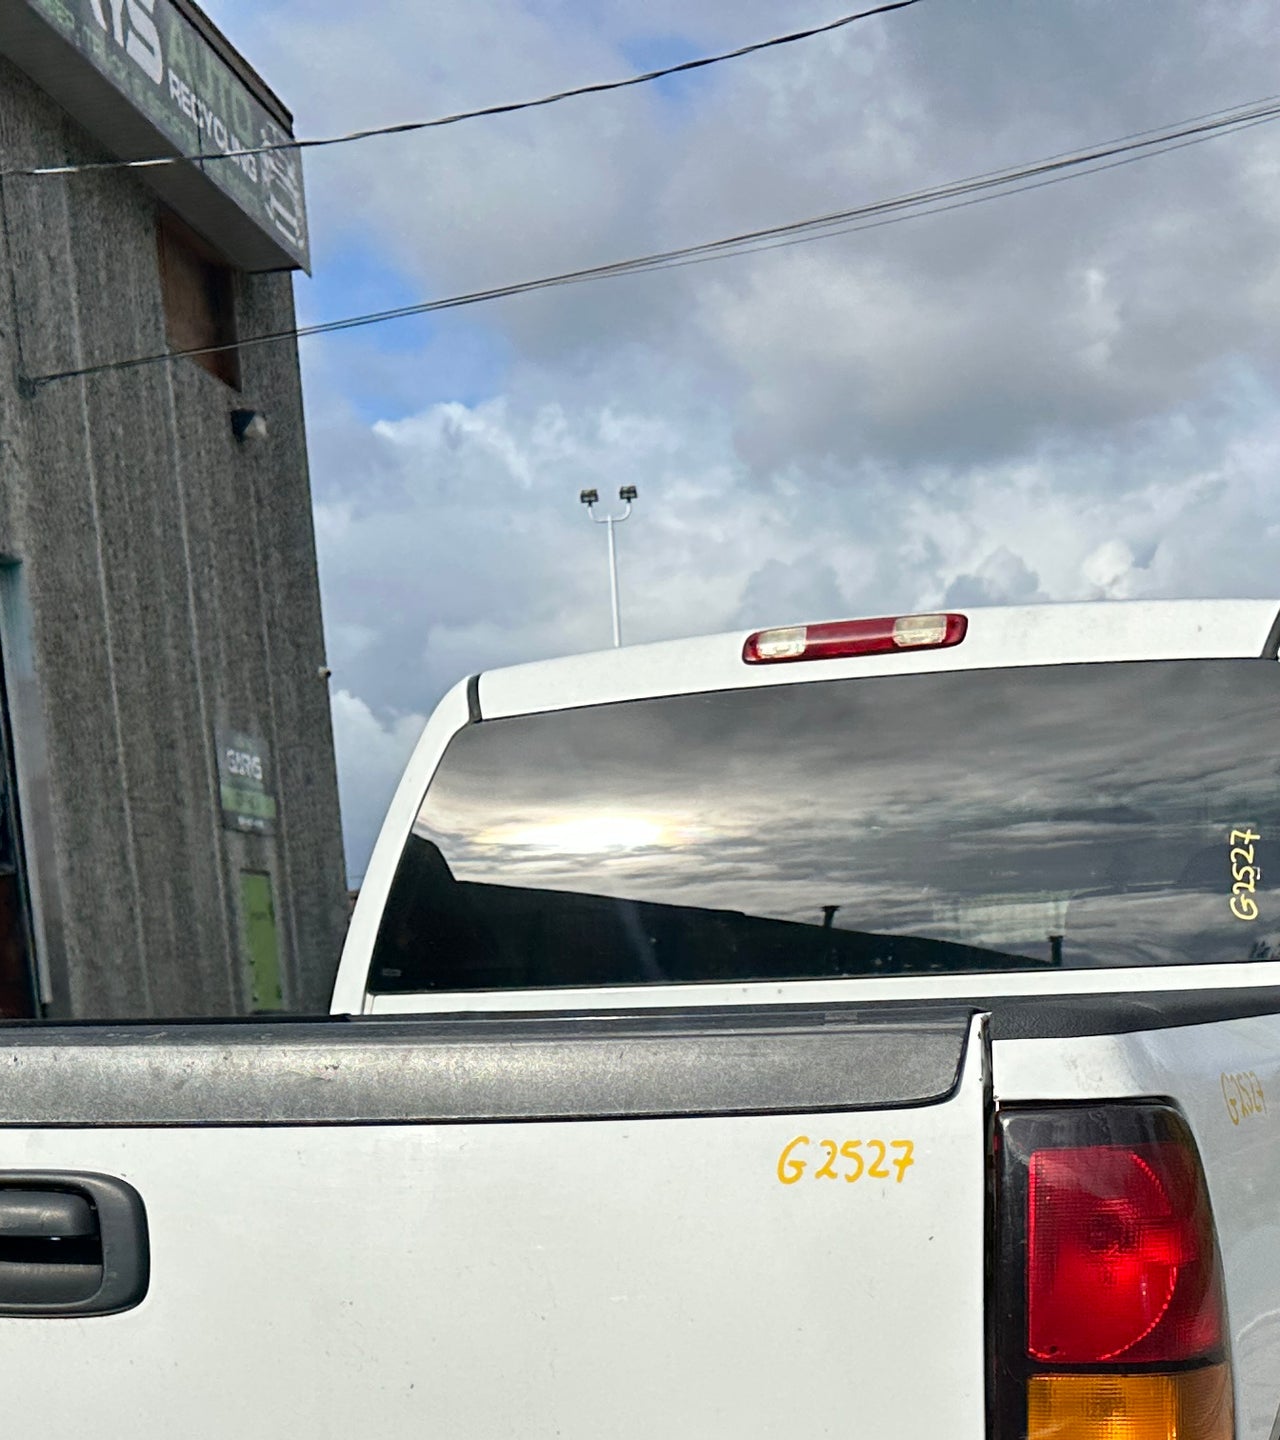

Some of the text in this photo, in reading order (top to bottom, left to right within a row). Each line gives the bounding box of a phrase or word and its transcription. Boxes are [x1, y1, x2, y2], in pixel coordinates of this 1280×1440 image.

[169, 14, 253, 149] AUTO
[169, 68, 258, 182] RECYCLING
[1230, 829, 1261, 920] G2527
